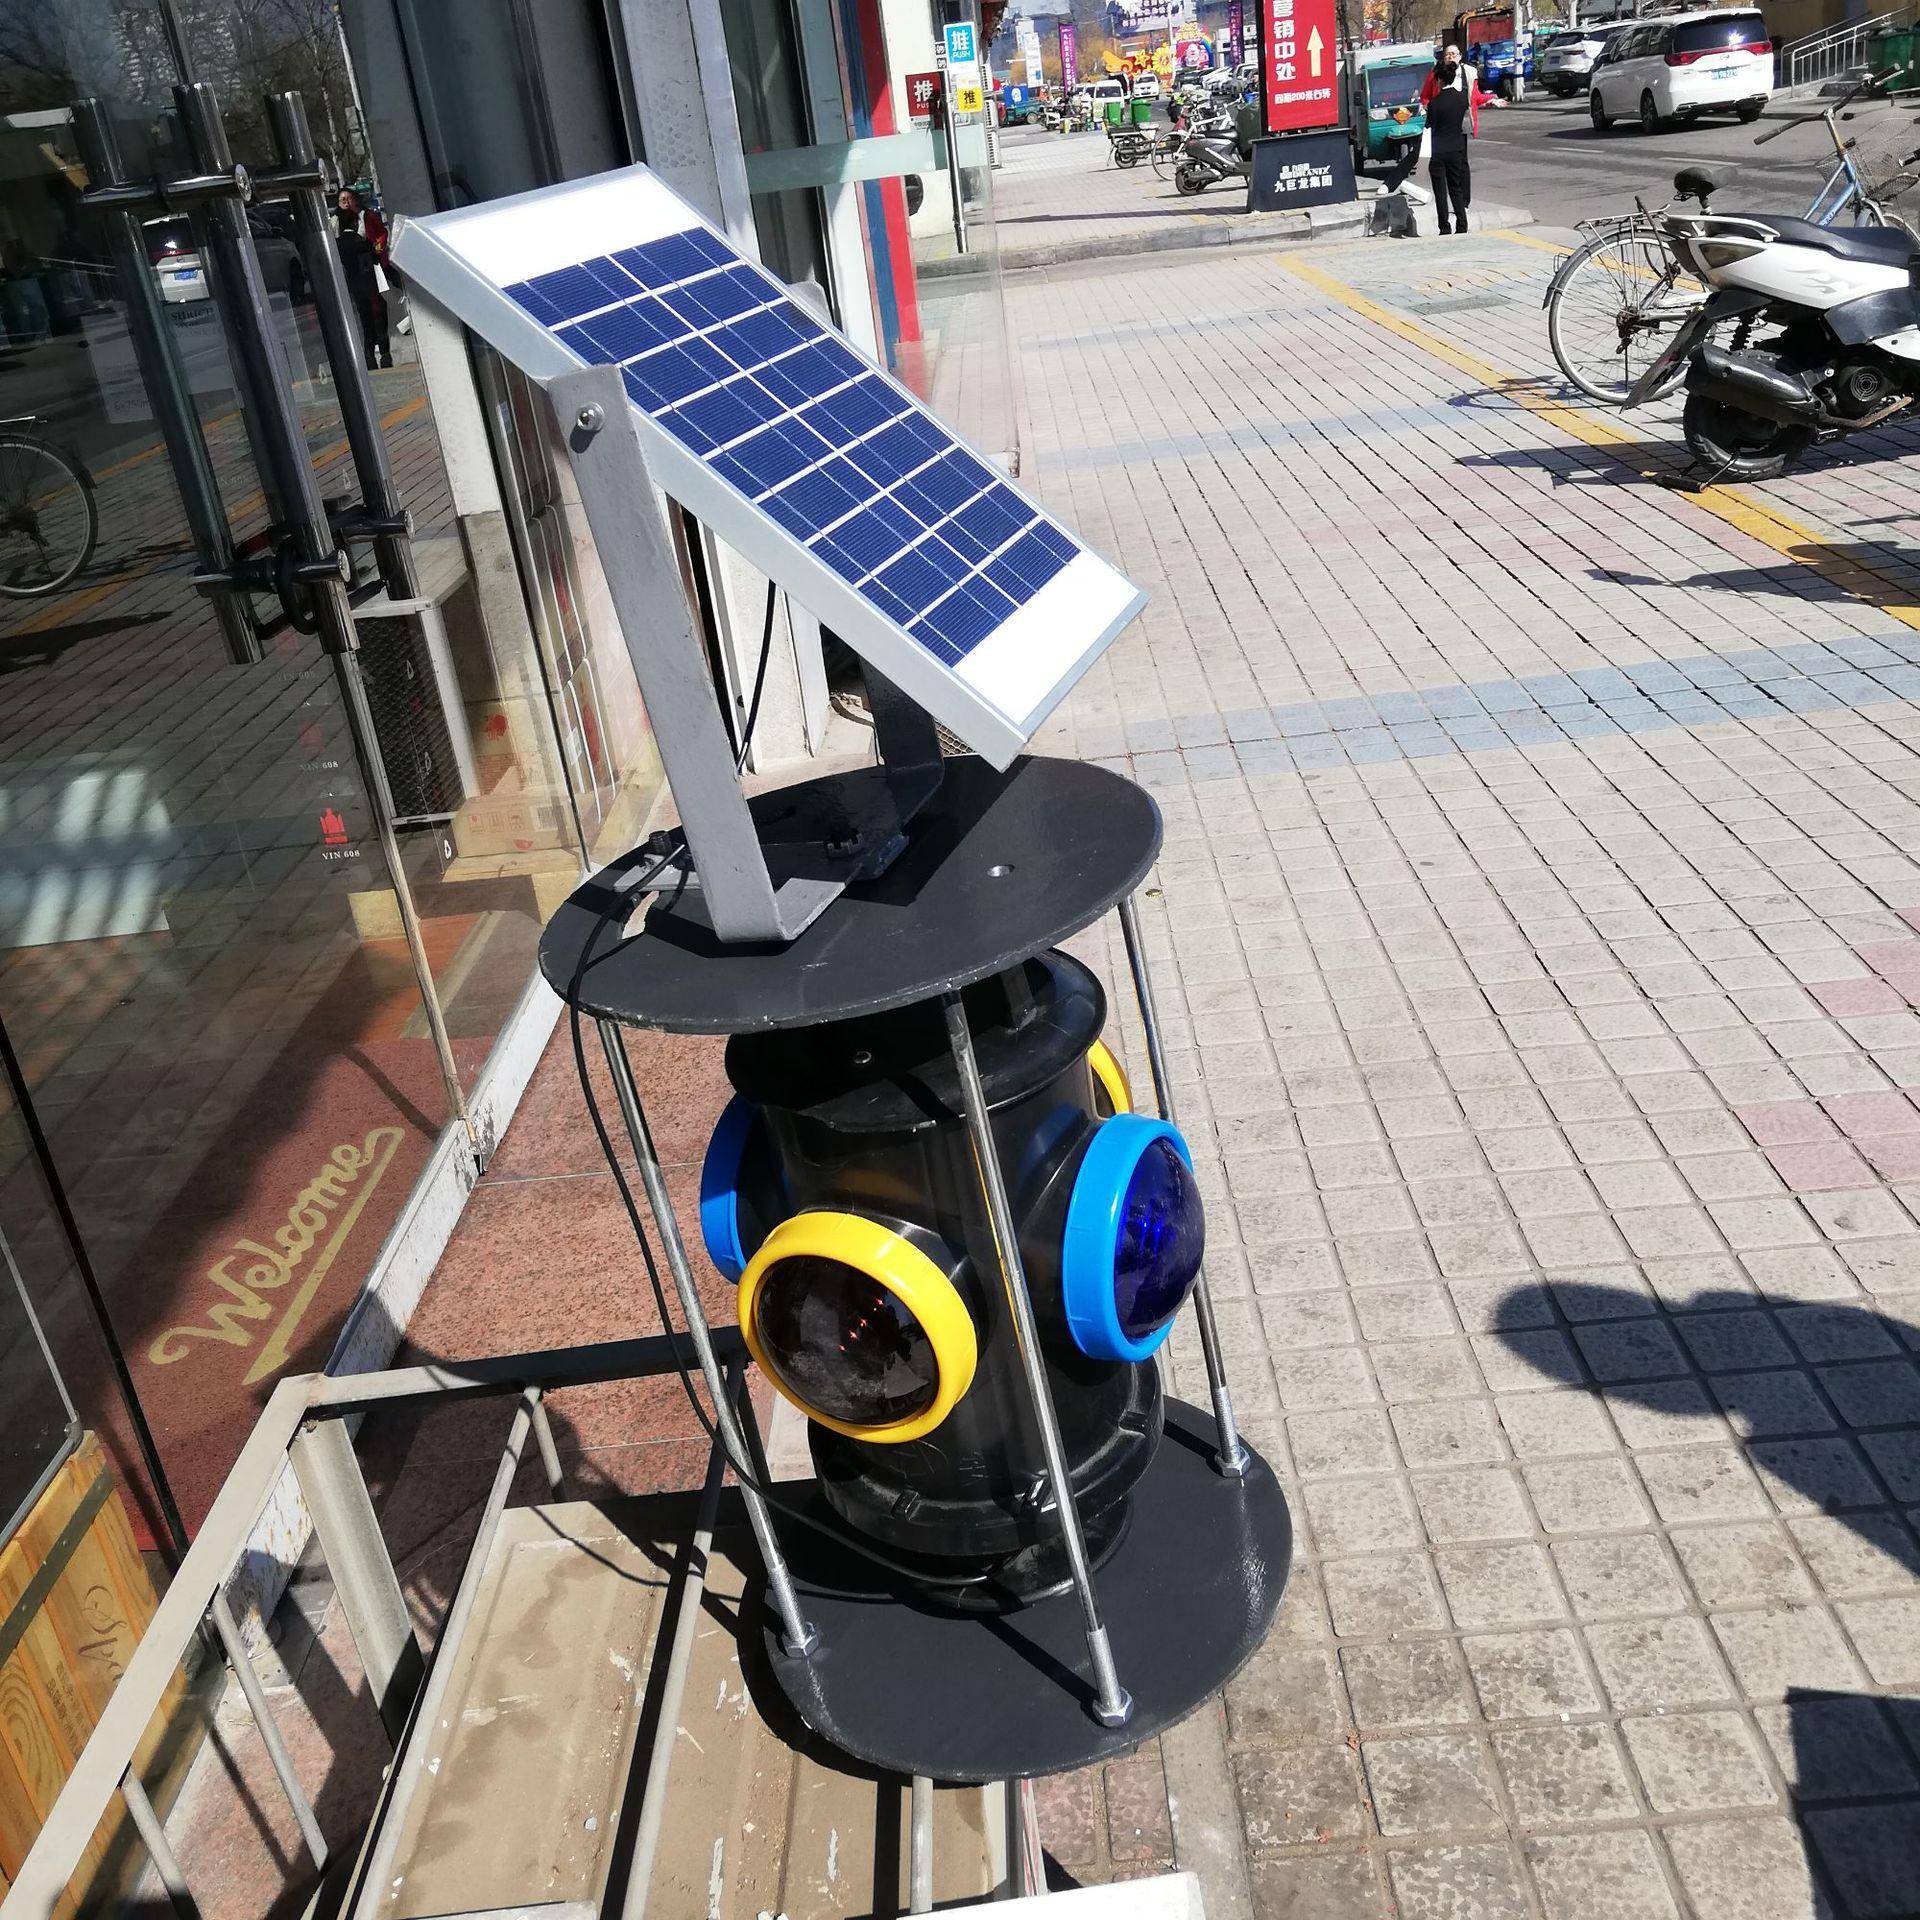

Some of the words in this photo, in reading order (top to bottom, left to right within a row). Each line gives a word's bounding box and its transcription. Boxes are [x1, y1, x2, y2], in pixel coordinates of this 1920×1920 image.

[951, 30, 968, 51] 推
[952, 50, 971, 58] PUSH
[914, 79, 934, 102] 推
[964, 90, 976, 104] 推
[1274, 174, 1333, 193] 九巨龙集团
[322, 760, 339, 769] 608
[322, 851, 341, 861] VIN
[343, 849, 360, 859] 608
[149, 1127, 404, 1366] Welcome
